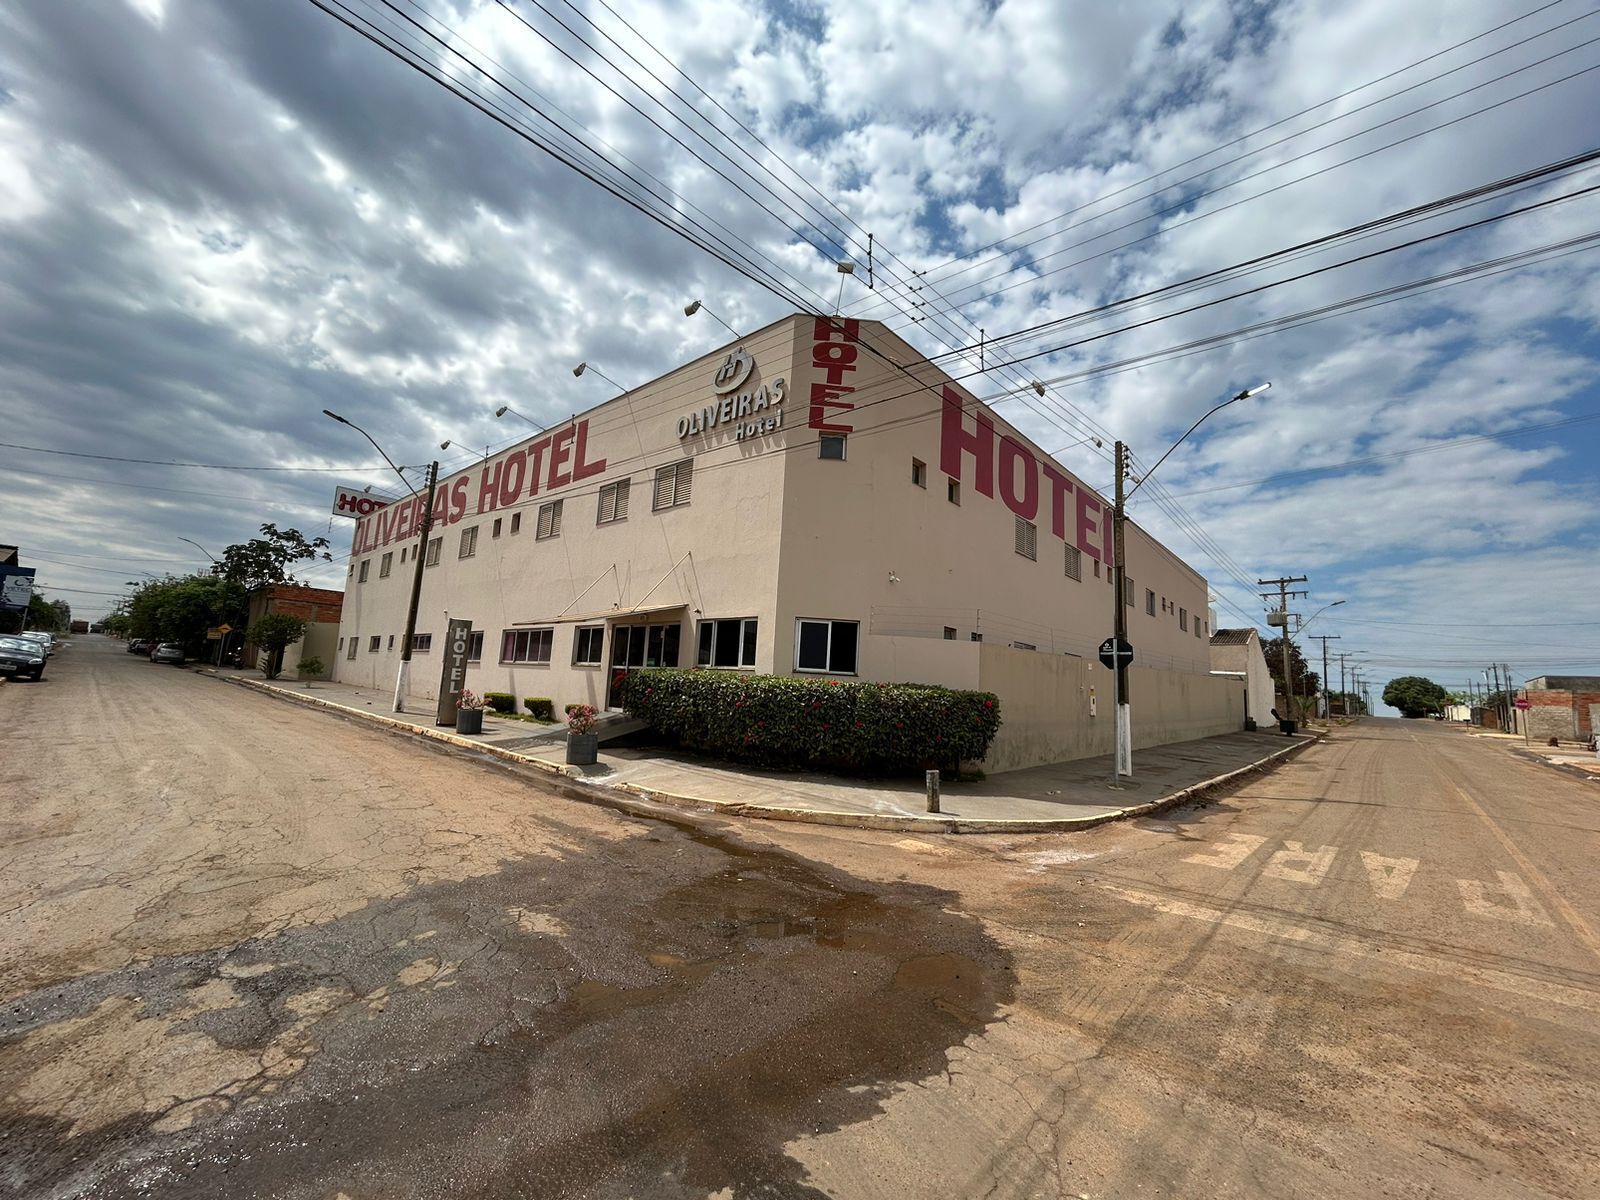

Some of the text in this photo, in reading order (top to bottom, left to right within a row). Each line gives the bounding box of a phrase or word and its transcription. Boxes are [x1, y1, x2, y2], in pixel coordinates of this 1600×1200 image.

[676, 378, 784, 439] OLIVEIRAS
[812, 318, 860, 432] HOTEL
[735, 410, 783, 440] Hotel
[352, 419, 607, 557] OLIVEIRAS HOTEL
[449, 627, 467, 694] HOTEL
